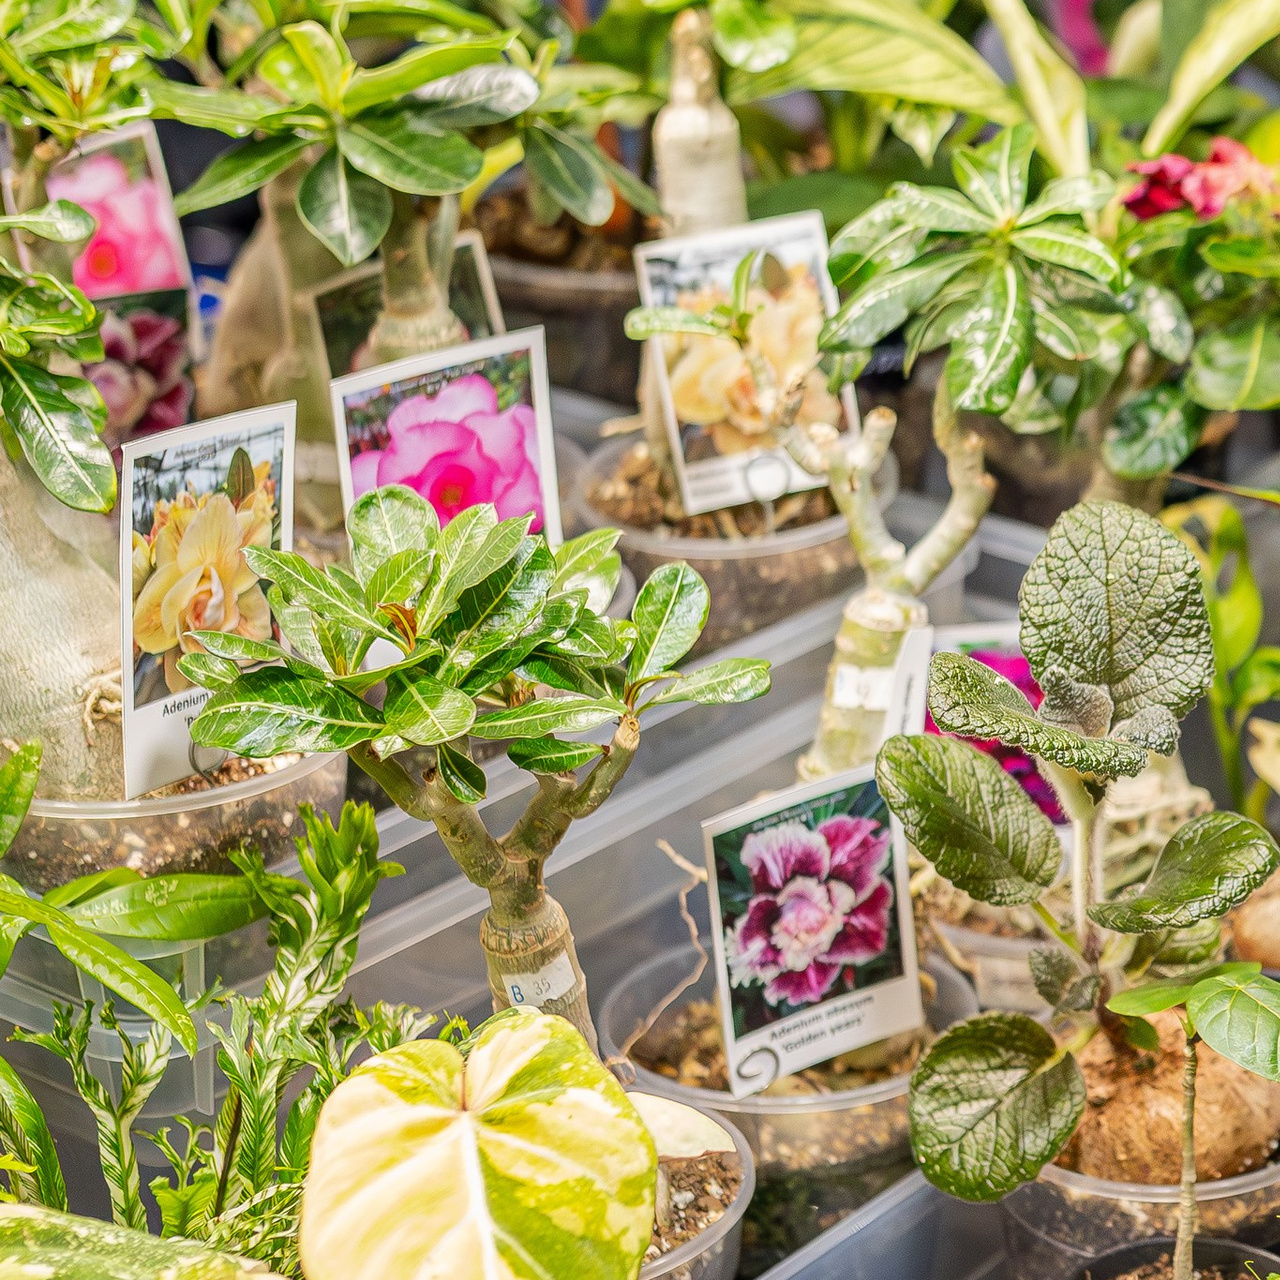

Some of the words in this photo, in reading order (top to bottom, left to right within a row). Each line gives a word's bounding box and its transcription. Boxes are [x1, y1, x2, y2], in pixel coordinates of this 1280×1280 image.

[162, 692, 209, 717] Adenium
[533, 978, 551, 996] 35
[770, 1014, 822, 1040] Adenium
